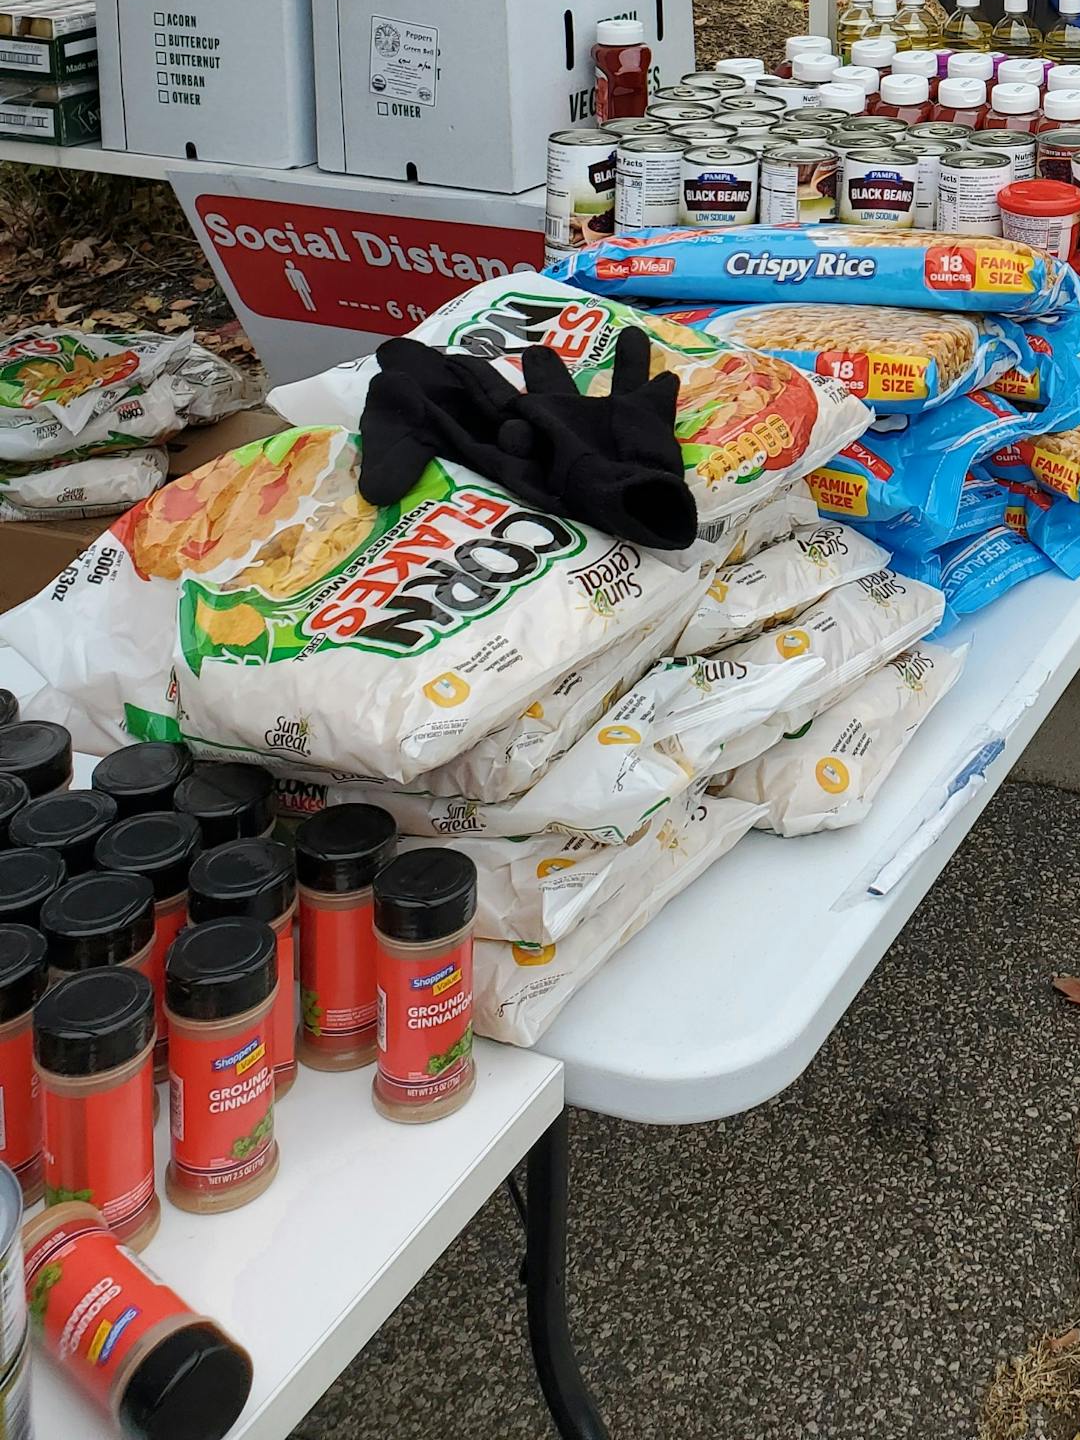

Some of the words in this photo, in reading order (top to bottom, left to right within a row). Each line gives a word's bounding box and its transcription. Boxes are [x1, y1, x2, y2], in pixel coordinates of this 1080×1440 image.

[167, 13, 197, 27] ACORN
[168, 34, 220, 50] BUTTERCUP
[405, 30, 433, 42] Peppers
[403, 44, 422, 53] Green
[66, 61, 87, 73] Made
[169, 53, 221, 68] BUTTERNUT
[170, 72, 206, 87] TURBAN
[172, 91, 201, 105] OTHER
[391, 103, 421, 118] OTHER
[622, 160, 643, 168] Facts
[703, 173, 731, 181] PAMPA
[940, 172, 957, 183] Facts
[686, 189, 716, 202] BLACK
[717, 190, 750, 203] BEANS
[851, 188, 883, 200] BLACK
[883, 189, 912, 202] BEANS
[946, 195, 957, 203] 300
[695, 213, 710, 221] LOW
[710, 213, 736, 222] SODIUM
[860, 212, 875, 220] LOW
[875, 213, 900, 221] SODIUM
[203, 212, 351, 262] Social
[726, 252, 814, 282] Crispy
[816, 253, 875, 277] Rice
[940, 255, 963, 272] 18
[930, 272, 972, 283] ounces
[989, 272, 1023, 285] SIZE
[386, 300, 403, 320] 6
[407, 303, 427, 322] ft
[830, 361, 855, 378] 18
[873, 361, 925, 378] FAMILY
[845, 380, 865, 390] ces
[882, 378, 915, 393] SIZE
[994, 383, 1027, 395] SIZE
[810, 474, 864, 498] FAMILY
[1041, 472, 1070, 492] SIZE
[820, 492, 853, 509] SIZE
[366, 500, 436, 555] Hojuelas
[818, 535, 849, 558] Sun
[87, 546, 118, 585] 500g
[310, 493, 511, 637] FLAKES
[345, 555, 368, 574] de
[575, 543, 642, 596] Cereal
[354, 511, 572, 648] CORN
[307, 575, 348, 612] Maíz
[604, 572, 643, 606] Sun
[879, 579, 906, 599] Sun
[705, 660, 748, 682] Sun
[273, 716, 300, 736] Sun
[265, 730, 308, 754] Cereal
[443, 803, 466, 819] Sun
[431, 816, 479, 832] Cereal
[413, 964, 454, 989] Shoppers
[437, 972, 462, 992] Value
[408, 991, 465, 1018] GROUND
[214, 1039, 259, 1070] Shoppers
[209, 1066, 268, 1101] GROUND
[209, 1069, 274, 1114] CINNAMO
[407, 1088, 418, 1097] NET
[418, 1087, 429, 1096] WT
[429, 1085, 439, 1095] 2.5
[439, 1083, 447, 1092] OZ
[208, 1175, 222, 1185] NET
[222, 1174, 233, 1184] WT
[233, 1171, 244, 1181] 2.5
[244, 1166, 252, 1176] OZ
